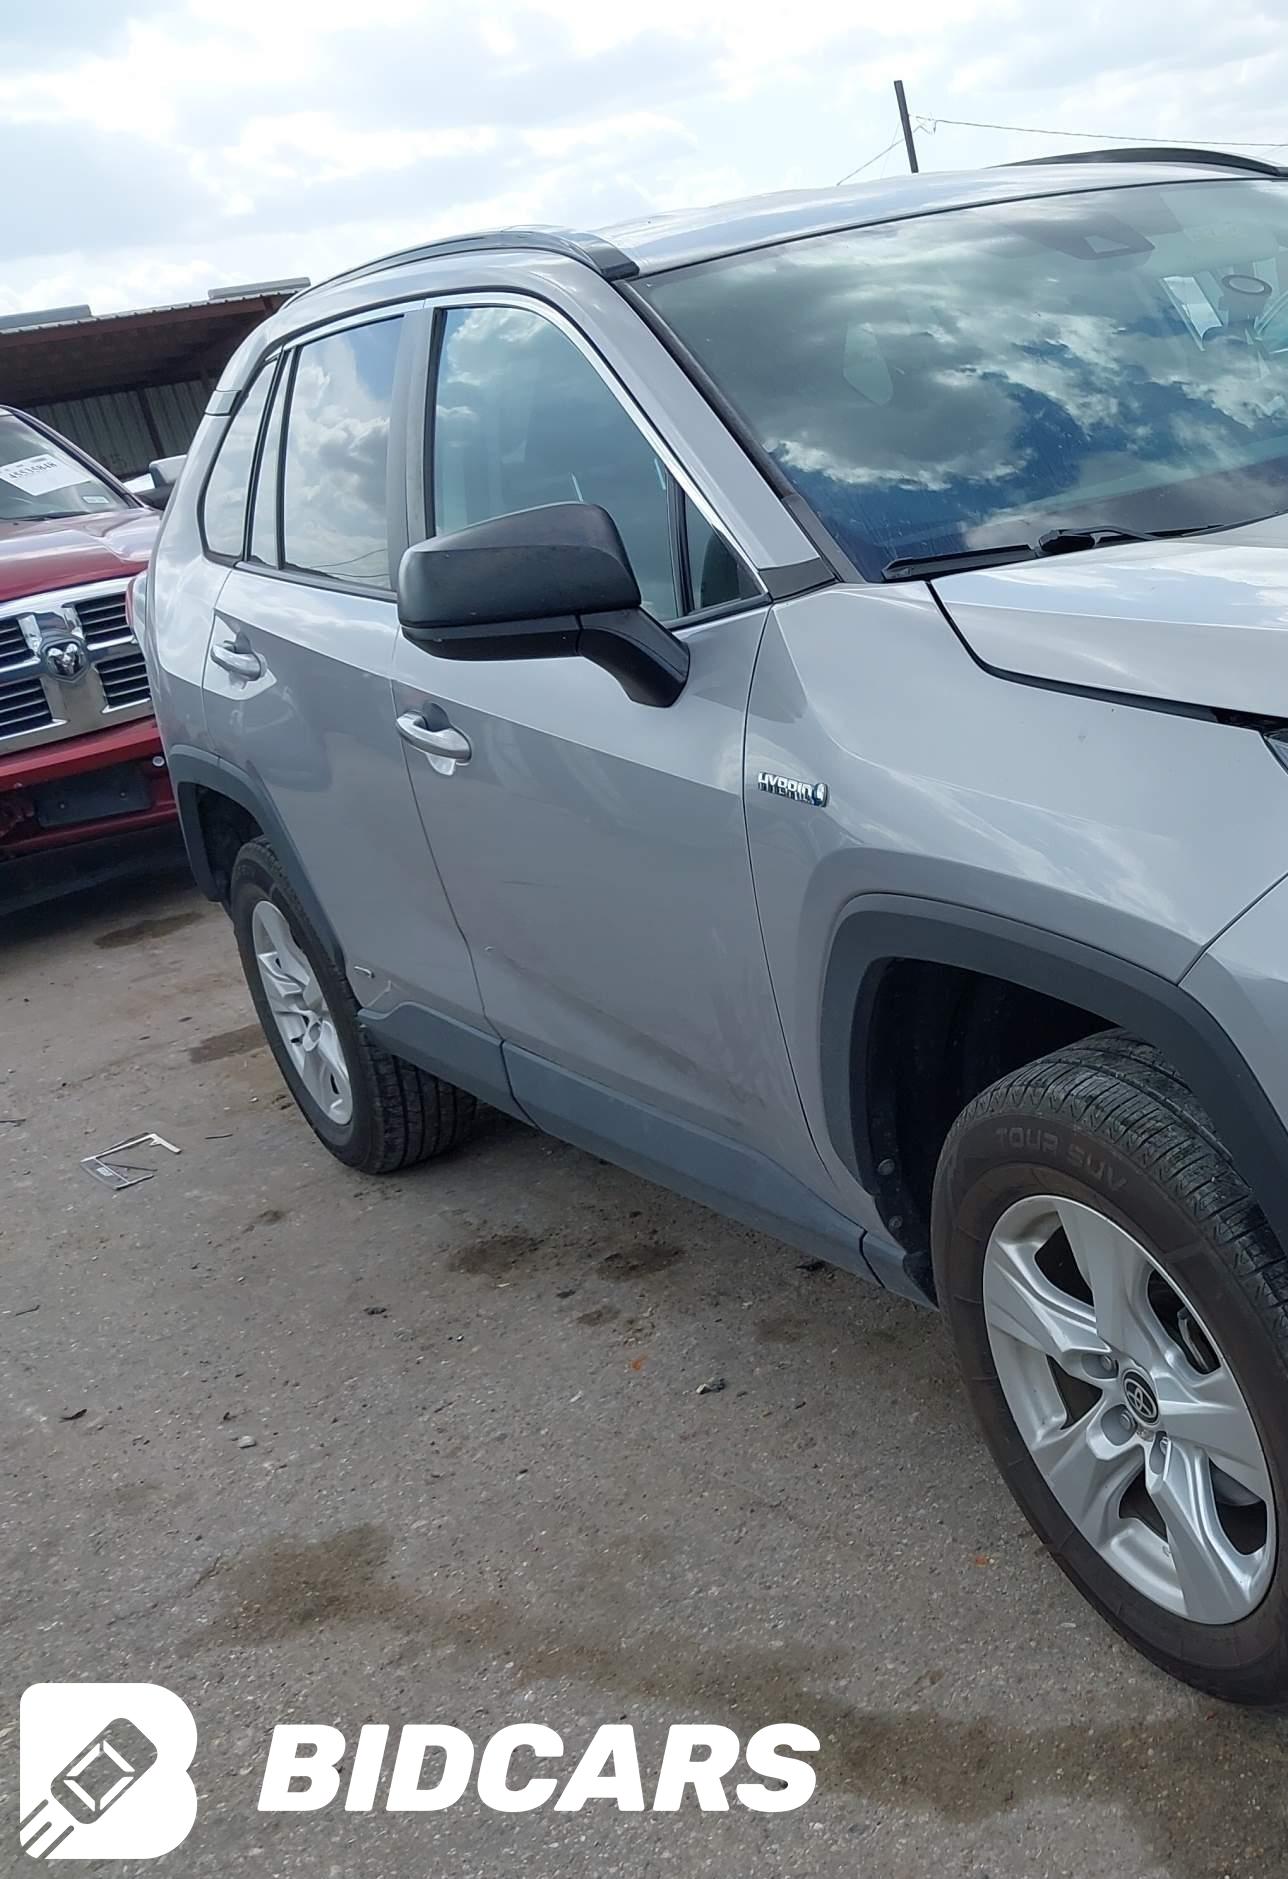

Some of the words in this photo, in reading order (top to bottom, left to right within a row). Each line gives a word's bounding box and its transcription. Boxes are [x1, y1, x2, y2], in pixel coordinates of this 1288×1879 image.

[758, 772, 814, 803] HYBRID
[996, 1126, 1059, 1154] TOUR
[1066, 1146, 1128, 1193] SUV
